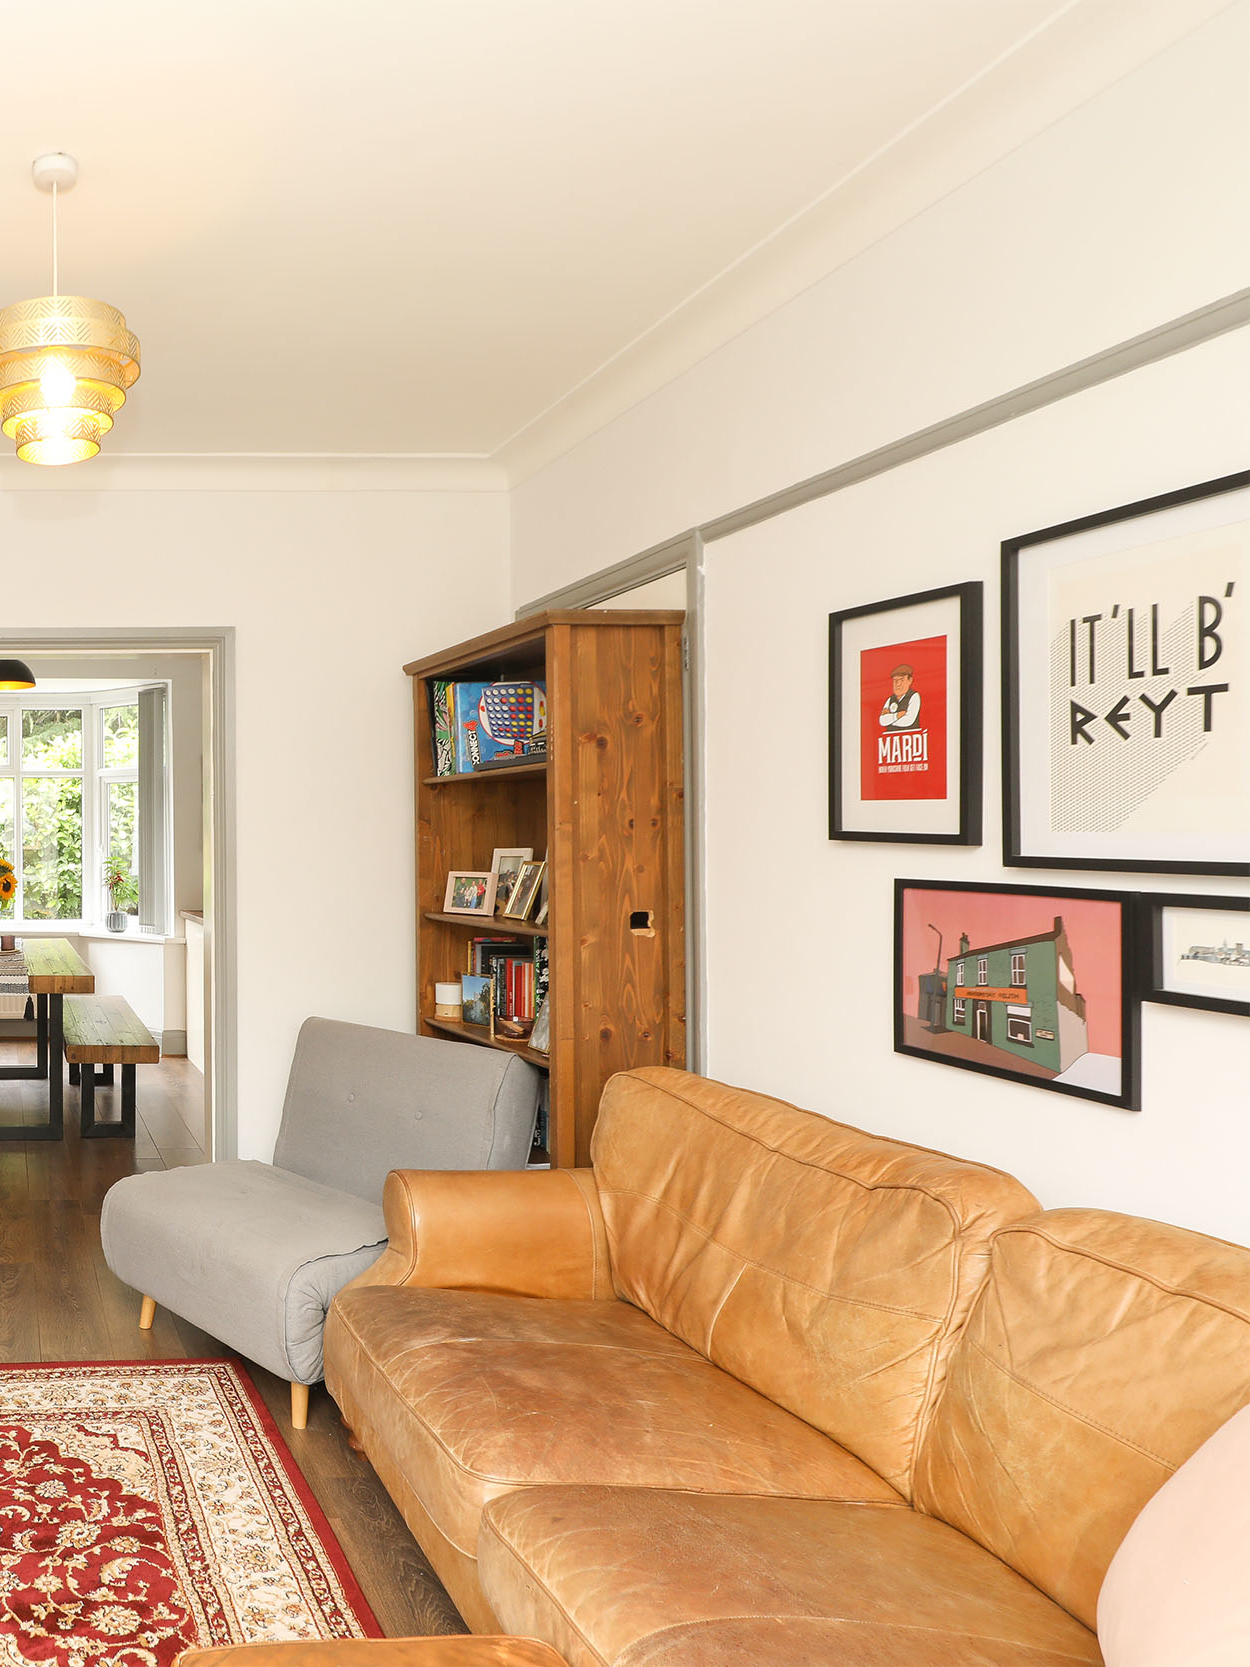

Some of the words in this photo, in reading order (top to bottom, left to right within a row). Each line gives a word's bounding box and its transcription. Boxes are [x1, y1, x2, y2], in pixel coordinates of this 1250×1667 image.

[1070, 603, 1170, 688] IT'LL
[1198, 581, 1235, 672] B'
[1069, 682, 1230, 746] REYT
